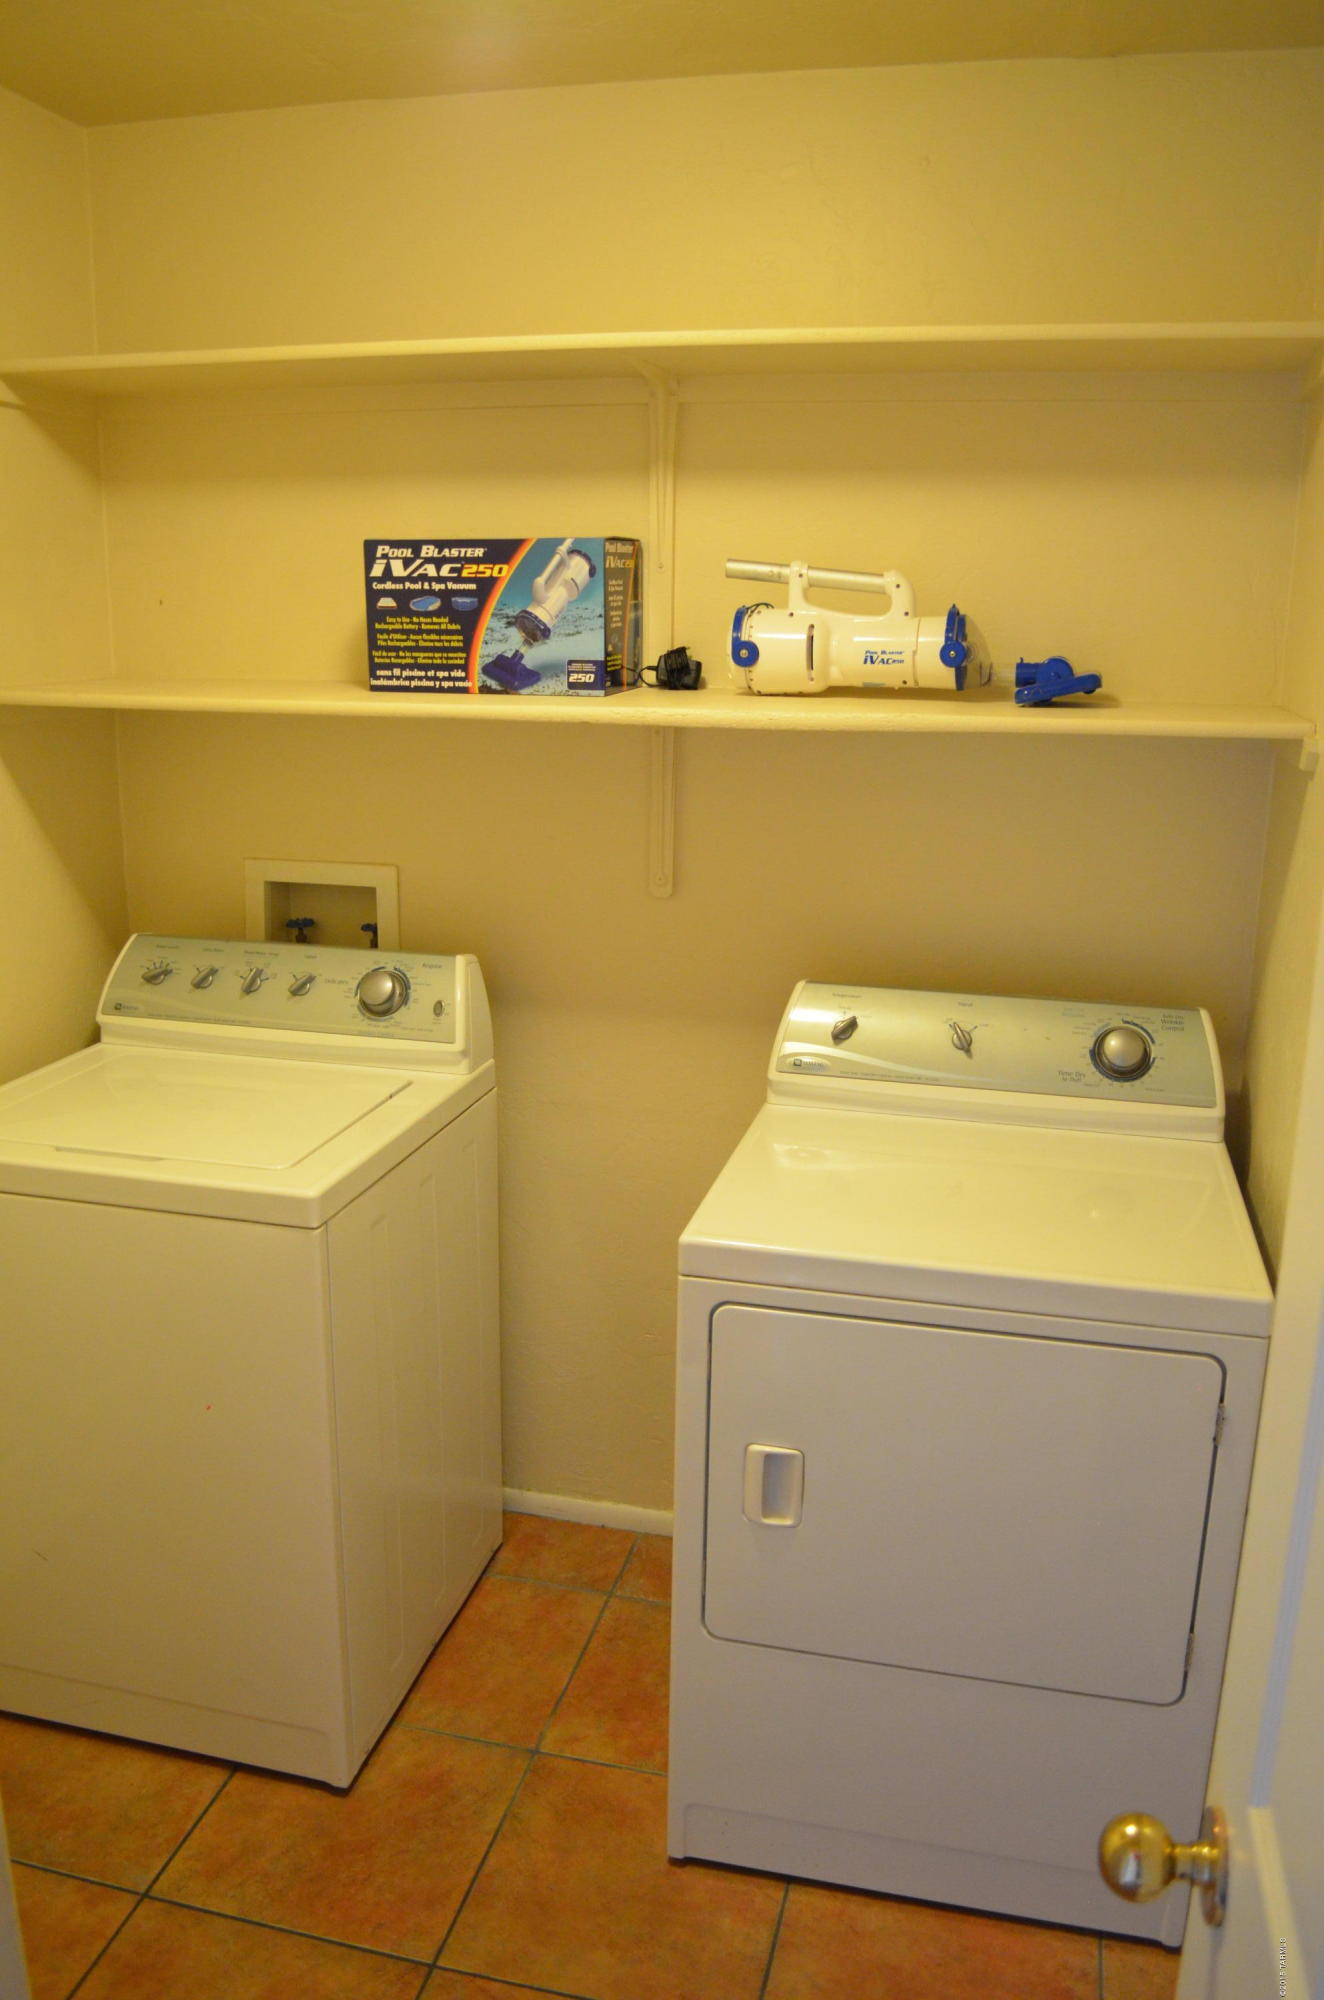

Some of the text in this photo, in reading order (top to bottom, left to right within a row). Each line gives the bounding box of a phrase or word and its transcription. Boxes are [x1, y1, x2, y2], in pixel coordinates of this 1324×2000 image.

[376, 544, 485, 557] POOL BLASTER
[372, 581, 403, 590] Cordless
[405, 581, 422, 590] Pool
[432, 582, 445, 591] Spa
[392, 668, 400, 676] fil
[402, 668, 426, 678] piscine
[436, 670, 449, 678] spa
[450, 669, 466, 677] vide
[569, 674, 595, 682] 250
